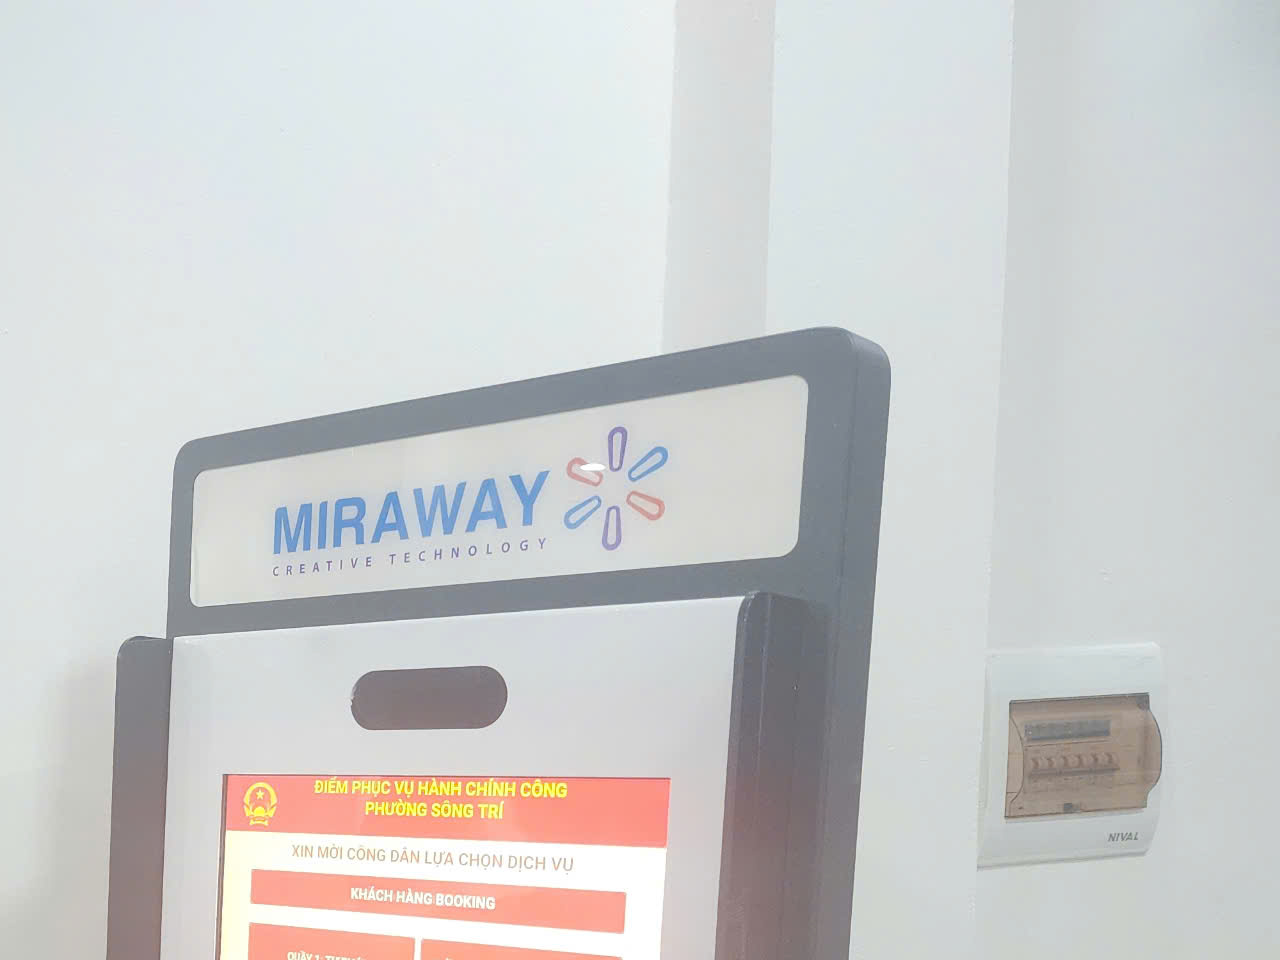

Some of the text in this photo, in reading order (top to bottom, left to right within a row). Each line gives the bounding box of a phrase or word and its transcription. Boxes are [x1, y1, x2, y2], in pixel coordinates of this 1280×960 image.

[273, 470, 550, 554] MIRAWAY
[272, 538, 547, 576] CREATIVE TECHNOLOGY
[352, 780, 391, 797] PHỤC
[394, 780, 414, 798] VỤ
[418, 777, 462, 796] HÀNH
[466, 777, 516, 797] CHÍNH
[520, 779, 568, 798] CÔNG
[365, 798, 505, 819] PHƯỜNG SÔNG TRÍ
[1108, 831, 1139, 842] NIVAL
[292, 844, 574, 875] XIN MỜI CÔNG DÂN LỰA CHỌN DỊCH VỤ
[350, 886, 496, 910] KHÁCH HÀNG BOOKING
